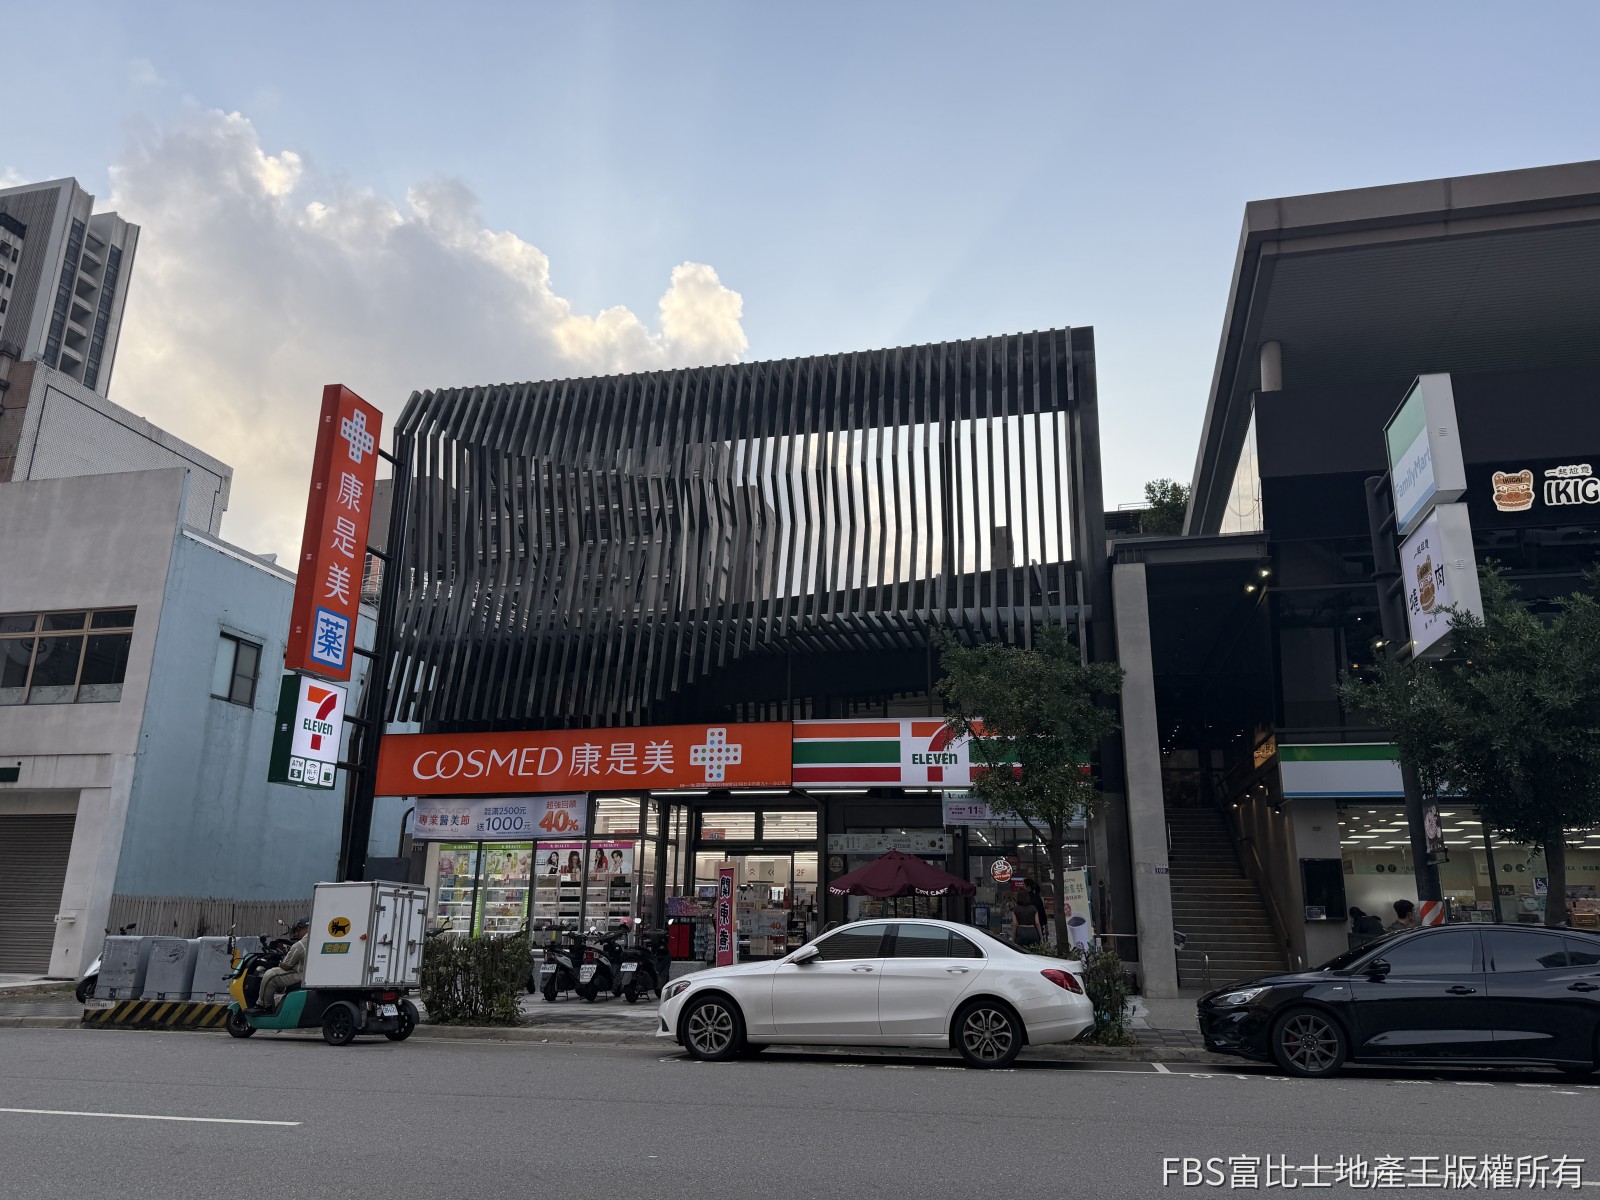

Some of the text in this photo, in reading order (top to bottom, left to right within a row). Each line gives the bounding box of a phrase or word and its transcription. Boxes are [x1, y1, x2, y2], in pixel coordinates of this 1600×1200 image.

[324, 471, 364, 606] 康是美
[1435, 563, 1445, 591] 肉
[291, 759, 304, 768] ATM
[412, 739, 675, 780] COSMED 康是美
[418, 814, 471, 826] 專業醫美節
[538, 810, 579, 832] 40%
[796, 868, 805, 876] 2F
[719, 874, 731, 952] 關東煮
